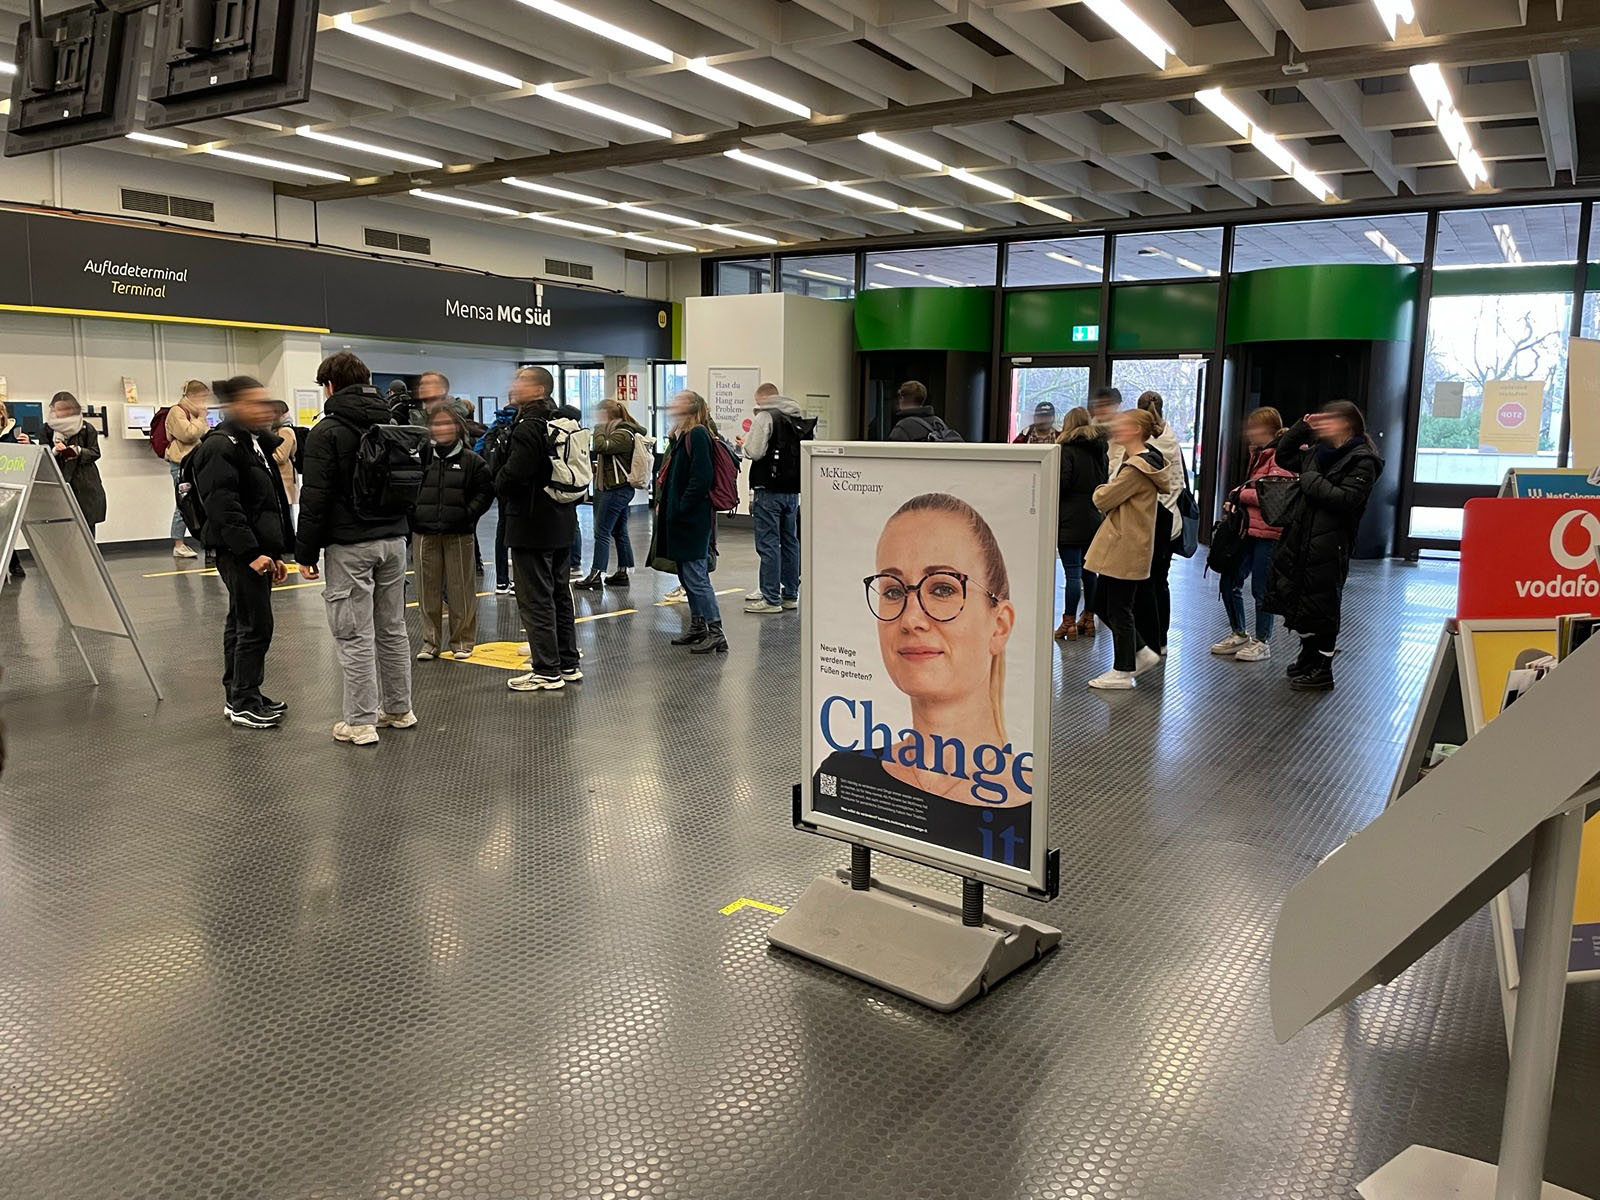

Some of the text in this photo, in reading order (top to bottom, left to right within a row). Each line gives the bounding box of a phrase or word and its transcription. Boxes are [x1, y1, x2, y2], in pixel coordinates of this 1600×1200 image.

[83, 259, 188, 282] Aufladeterminal
[111, 280, 166, 298] Terminal
[446, 298, 551, 327] Mensa MG Süd
[715, 381, 741, 389] Hast du
[715, 397, 734, 405] Hang
[715, 405, 745, 413] Problem-
[820, 467, 862, 479] McKinsey
[832, 480, 884, 494] & Company
[1515, 574, 1600, 598] vodafo
[820, 643, 857, 657] Neue Wege
[820, 656, 844, 665] werden
[820, 665, 873, 681] Füßen getreten?
[819, 695, 1033, 805] Change
[978, 810, 1025, 870] it
